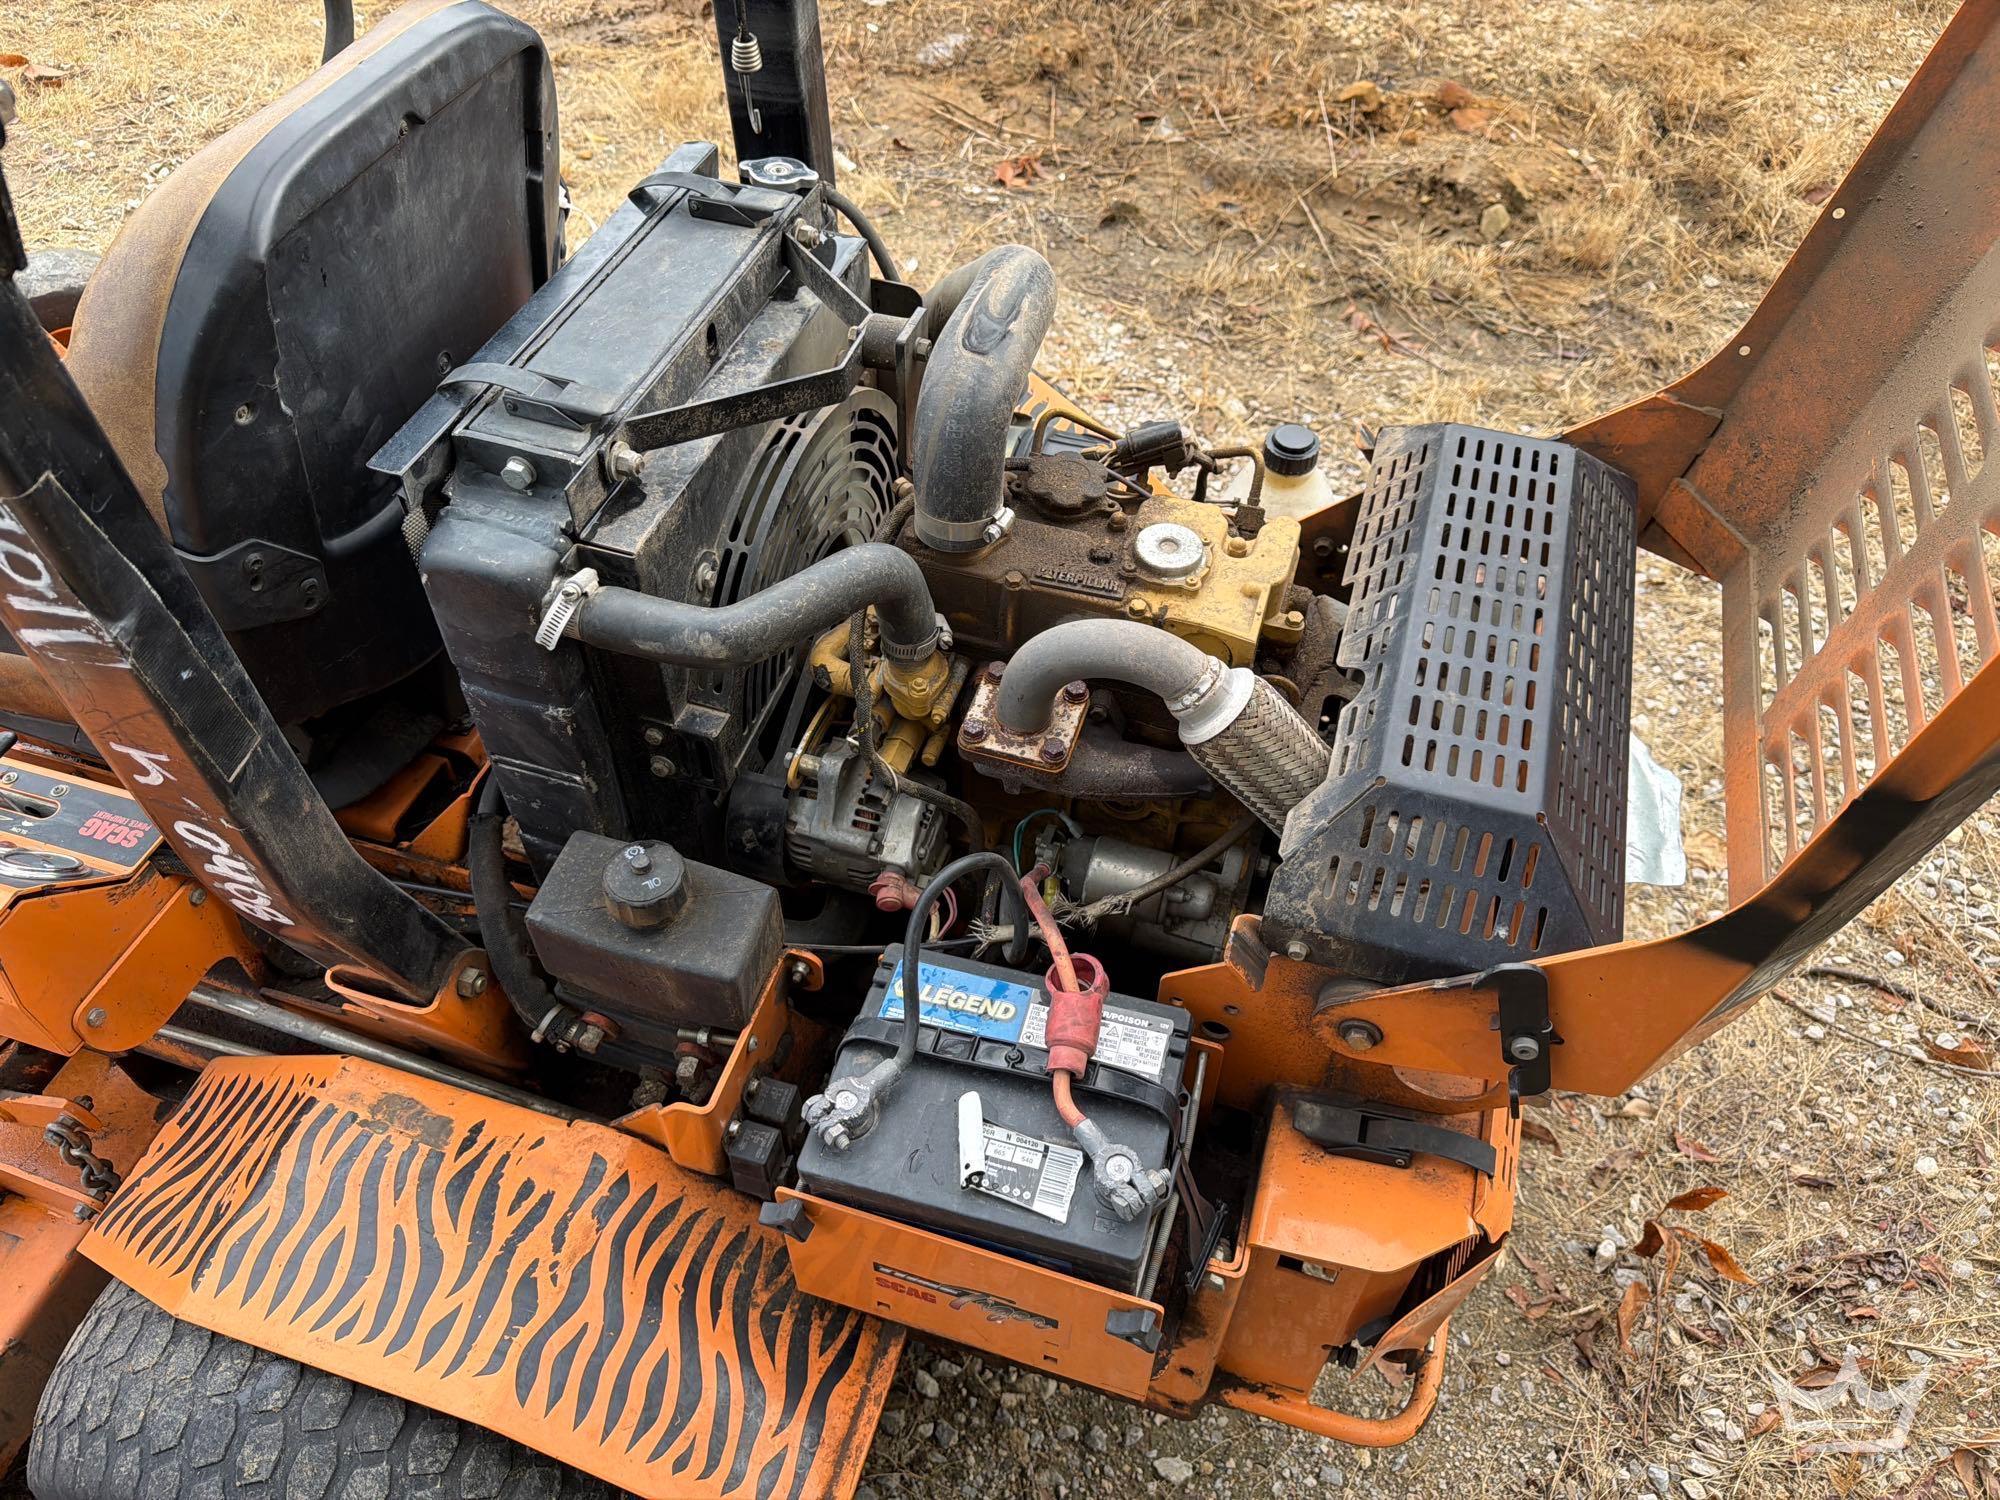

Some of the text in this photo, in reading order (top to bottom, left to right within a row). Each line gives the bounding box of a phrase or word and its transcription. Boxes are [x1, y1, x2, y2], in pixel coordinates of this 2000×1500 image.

[1034, 568, 1120, 592] CATERPILLAR
[79, 818, 144, 848] SCAG
[641, 877, 662, 889] OIL
[920, 983, 1017, 1021] LEGEND
[1101, 1010, 1149, 1027] R/POISON
[875, 1276, 937, 1304] SCAG
